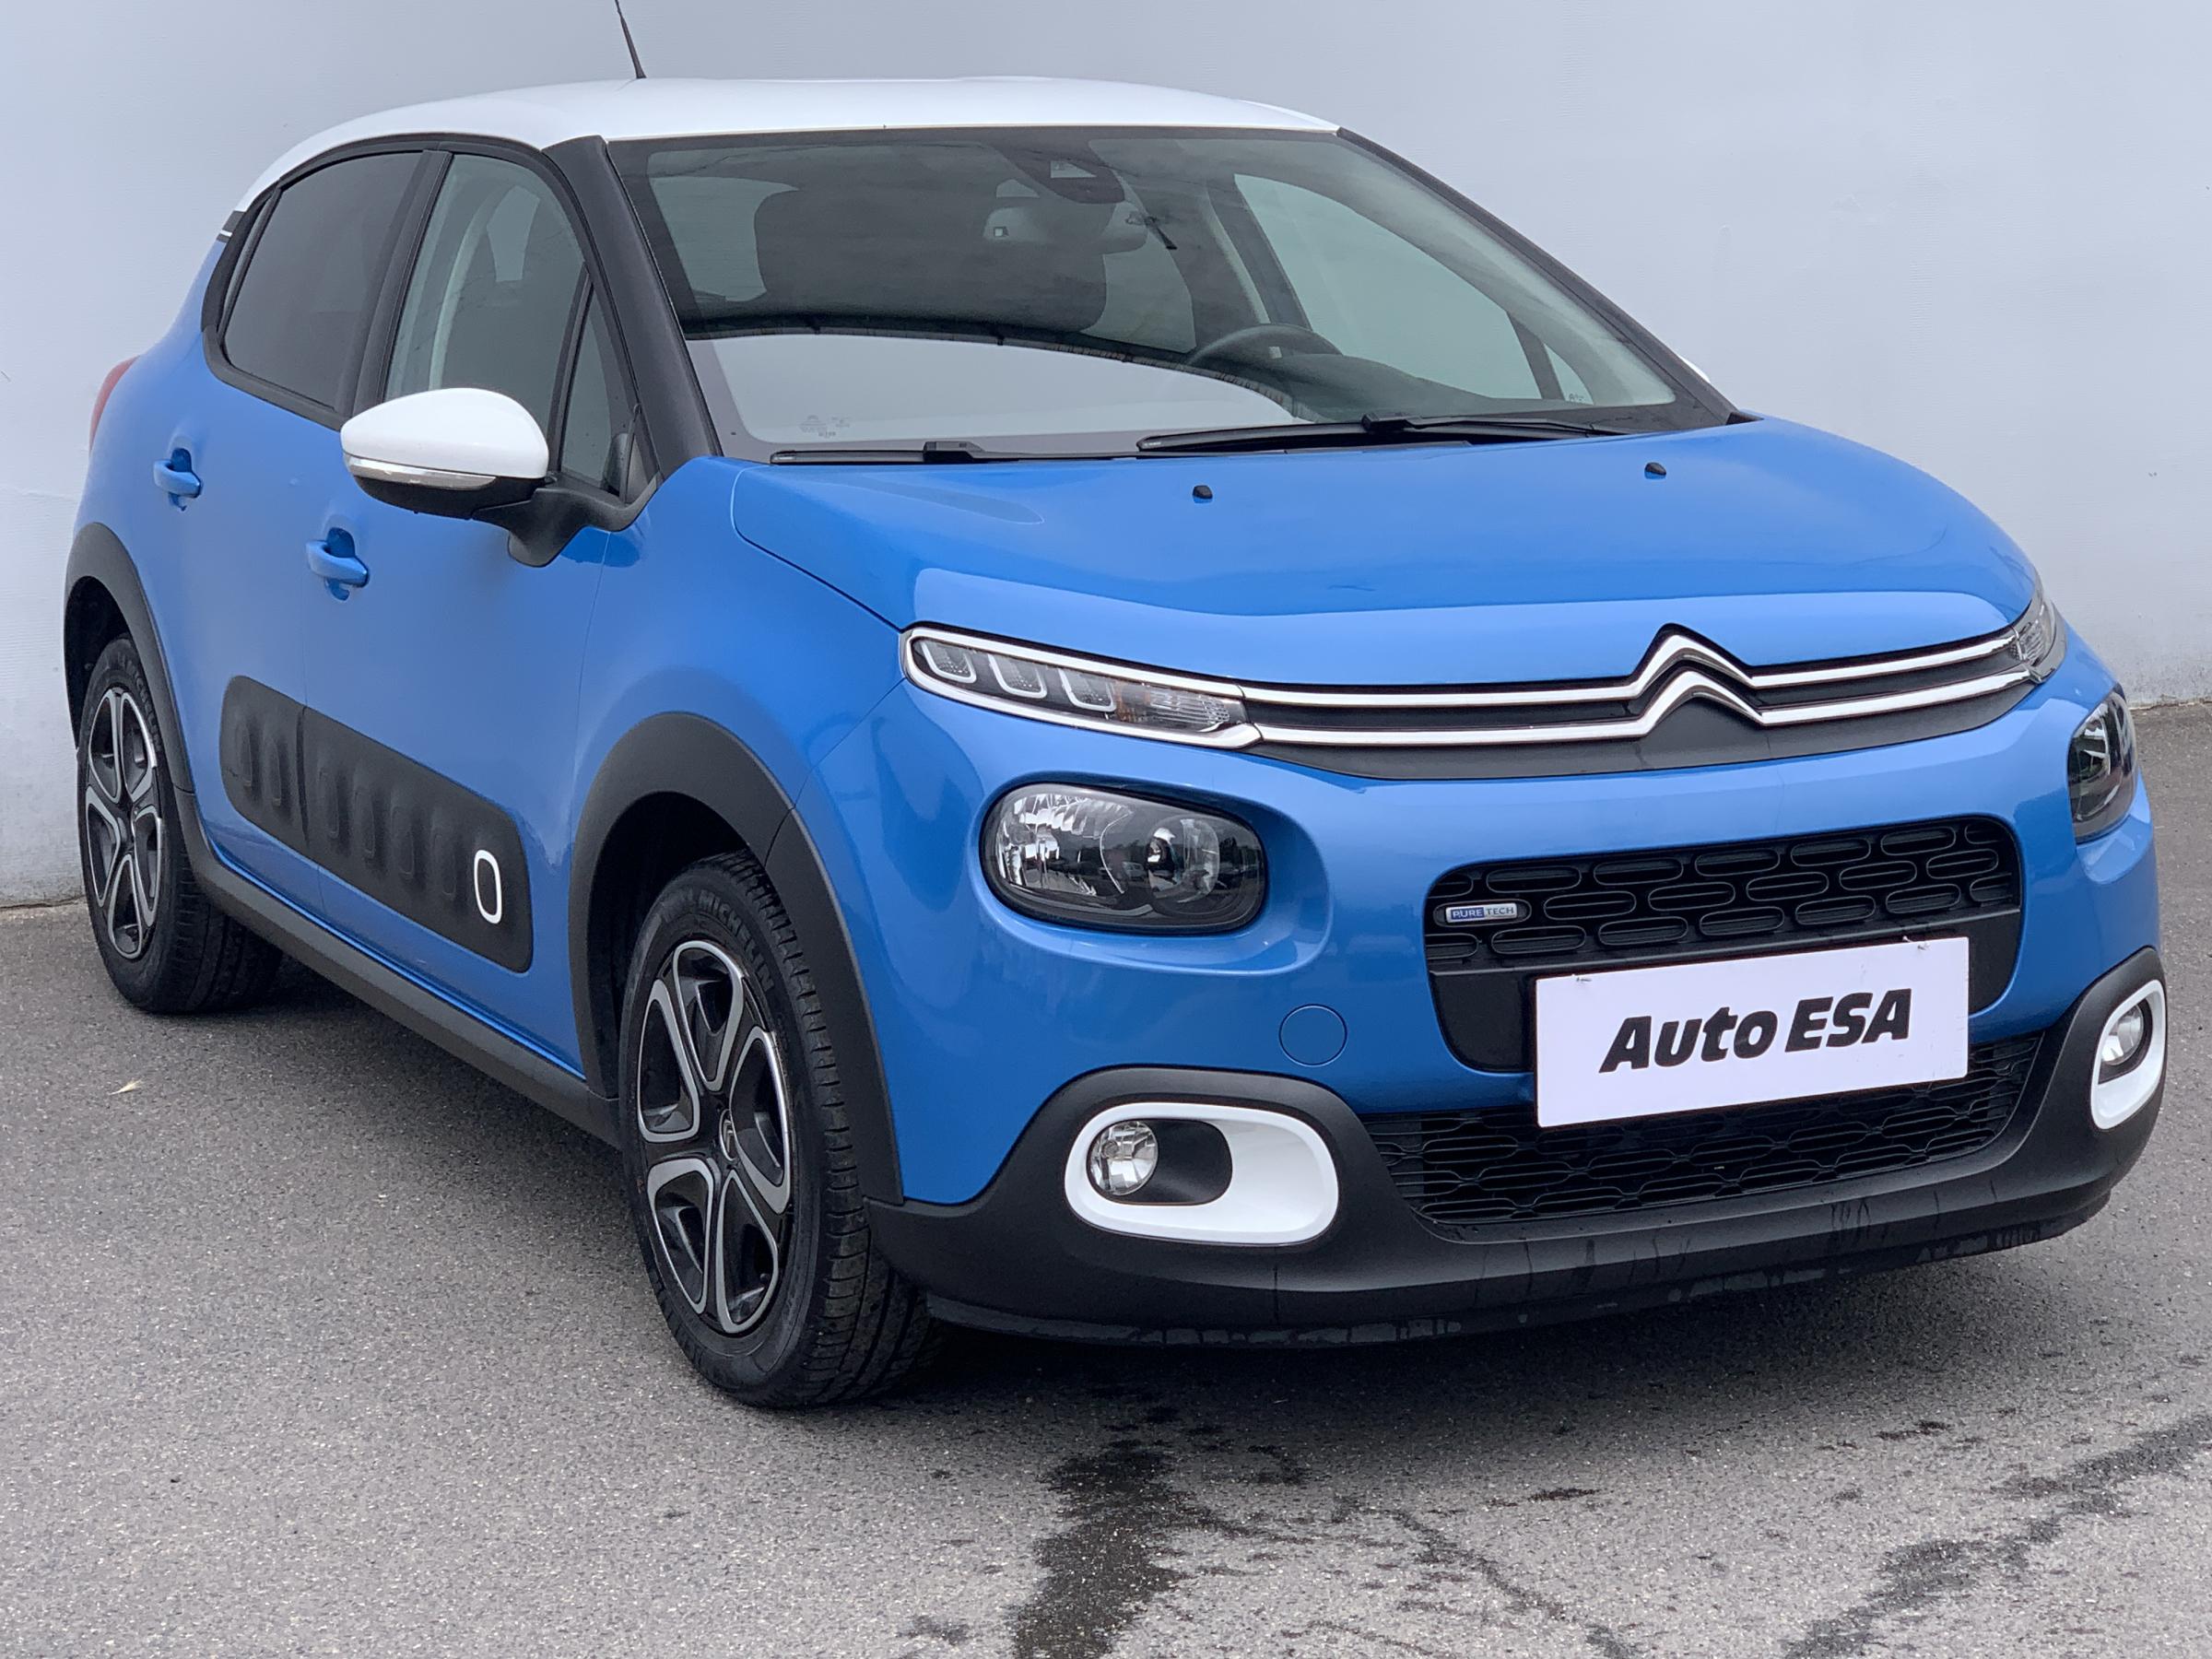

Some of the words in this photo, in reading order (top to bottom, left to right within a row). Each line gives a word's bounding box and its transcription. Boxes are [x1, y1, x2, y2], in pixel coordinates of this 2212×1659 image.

[698, 888, 775, 993] MICHELIN
[1452, 908, 1483, 919] PURE
[1486, 906, 1514, 915] TECH
[1598, 1006, 1779, 1074] Auto
[1784, 988, 1912, 1053] ESA
